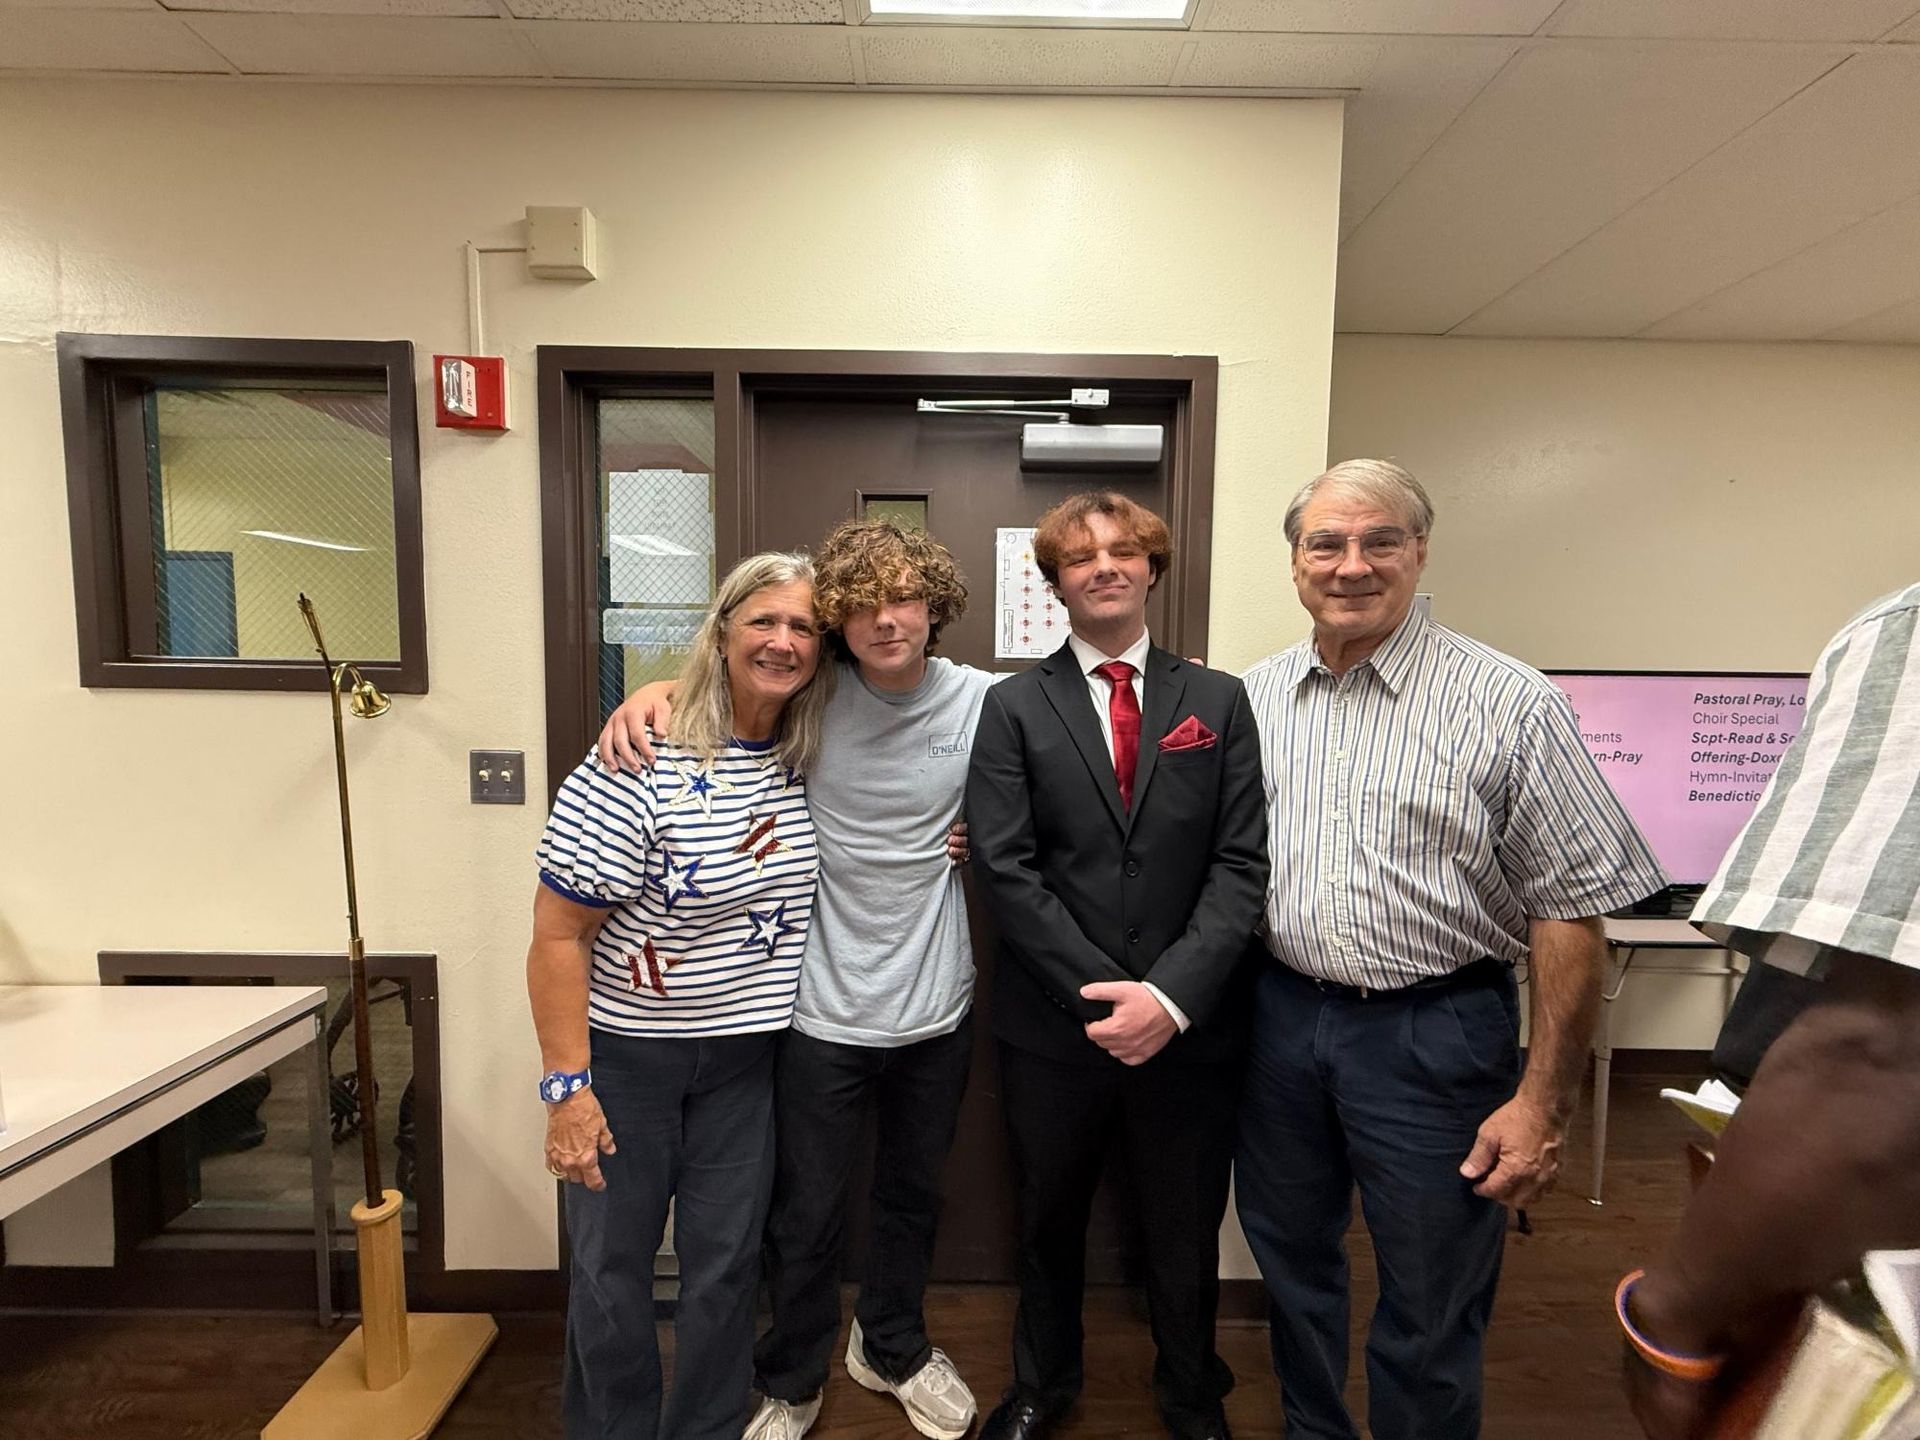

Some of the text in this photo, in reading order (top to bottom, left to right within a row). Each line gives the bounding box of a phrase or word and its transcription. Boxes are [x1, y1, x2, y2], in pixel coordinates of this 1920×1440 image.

[1694, 693, 1750, 706] Pastoral
[1753, 693, 1786, 708] Pray,
[1692, 712, 1779, 726] Choir Special
[1691, 732, 1764, 746] Scpt-Read
[1766, 733, 1776, 744] &
[932, 743, 965, 755] O'NEILL
[1688, 790, 1761, 802] Benedictio
